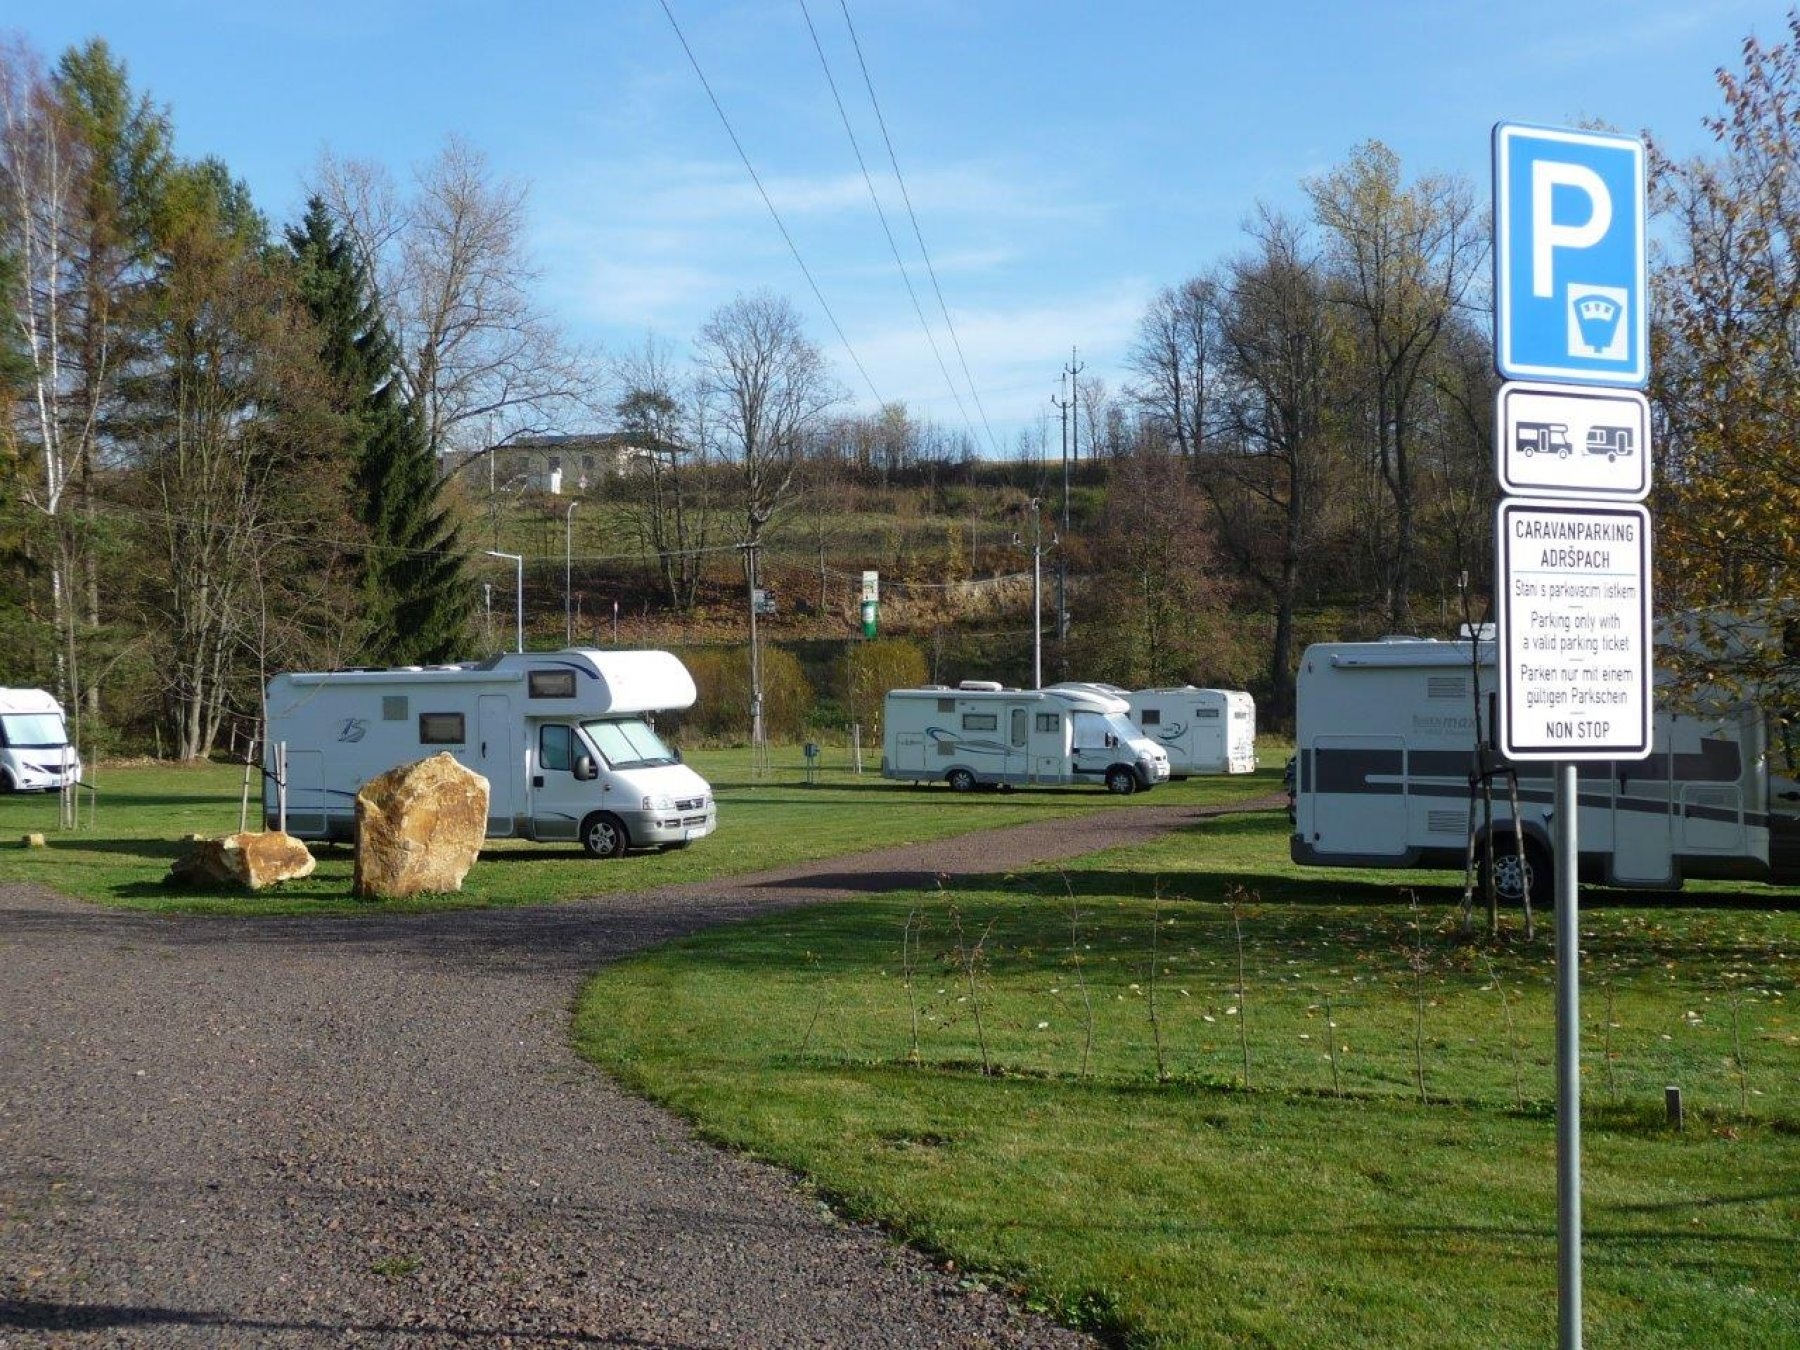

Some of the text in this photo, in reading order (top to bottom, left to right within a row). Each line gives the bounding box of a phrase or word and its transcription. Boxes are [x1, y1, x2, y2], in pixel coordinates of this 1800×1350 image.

[1532, 160, 1613, 298] P
[1515, 519, 1634, 542] CARAVANPARKING
[1540, 546, 1610, 569] ADRŠPACH
[1541, 584, 1546, 597] s
[1531, 611, 1620, 633] Parking only with
[1523, 635, 1629, 654] a valid parking ticket
[1521, 664, 1633, 681] Parken nur mit einem
[1527, 687, 1627, 708] gültigen Parkschein
[1547, 722, 1610, 738] NON STOP
